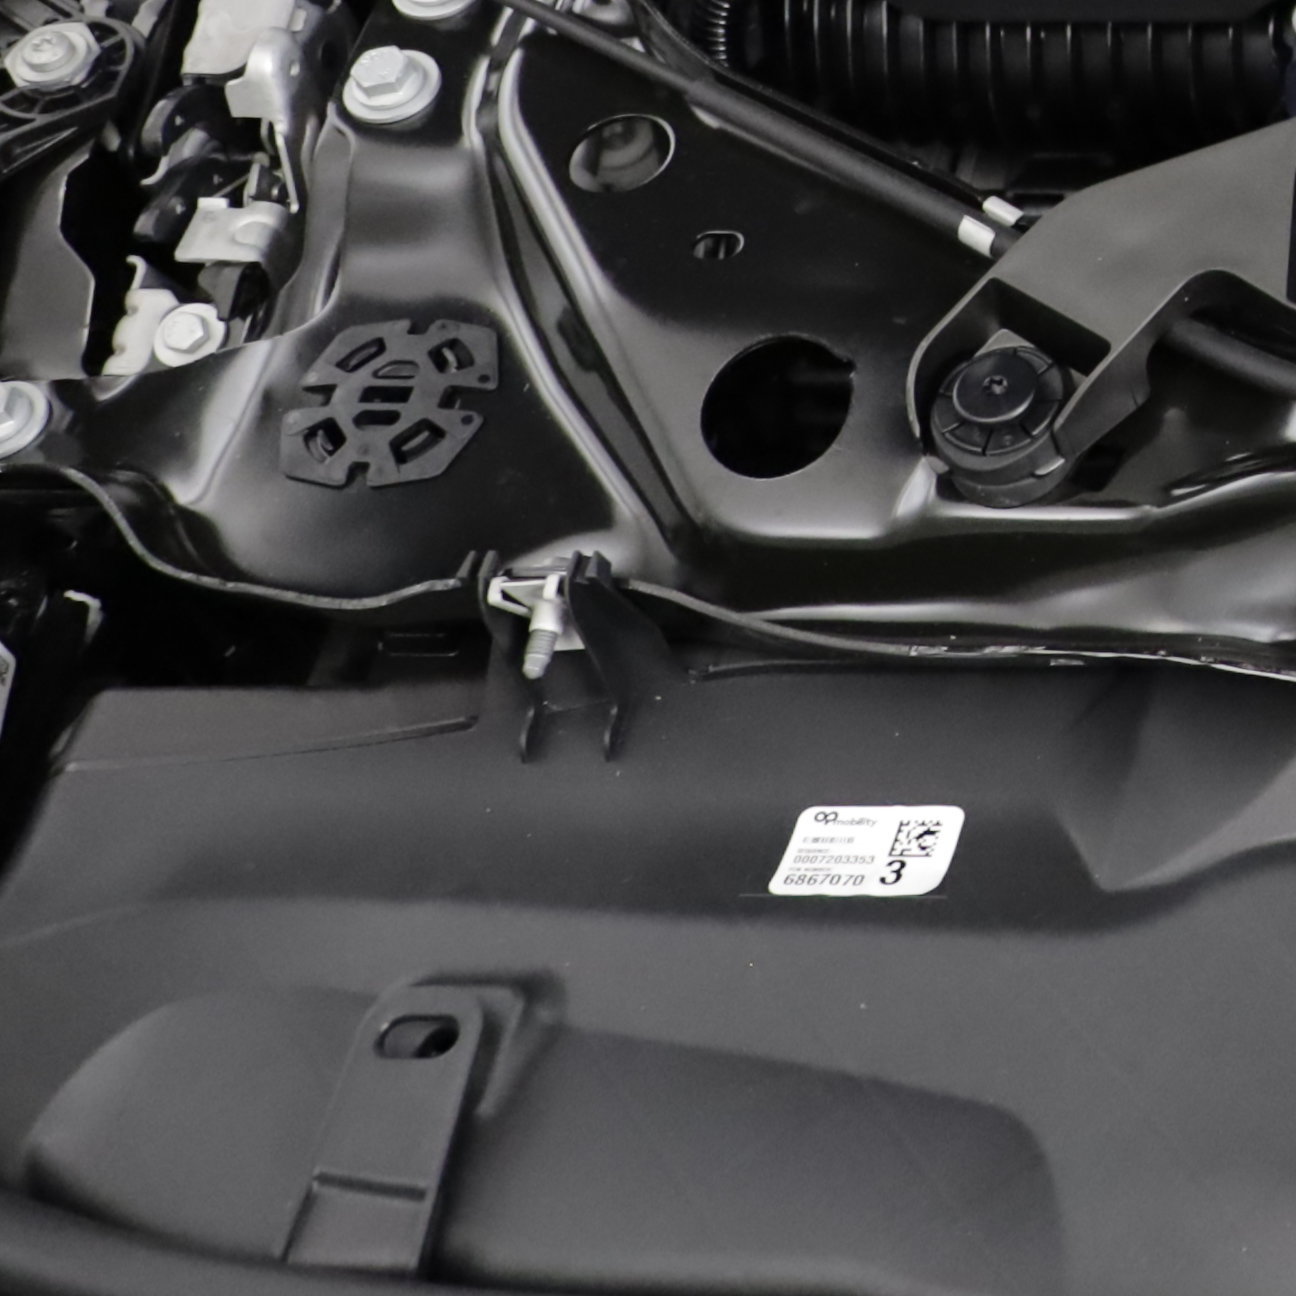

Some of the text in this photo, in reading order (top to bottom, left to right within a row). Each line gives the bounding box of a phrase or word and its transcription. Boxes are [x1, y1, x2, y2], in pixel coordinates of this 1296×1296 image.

[793, 855, 876, 865] 0007203353
[879, 859, 907, 886] 3
[783, 873, 866, 886] 6867070
